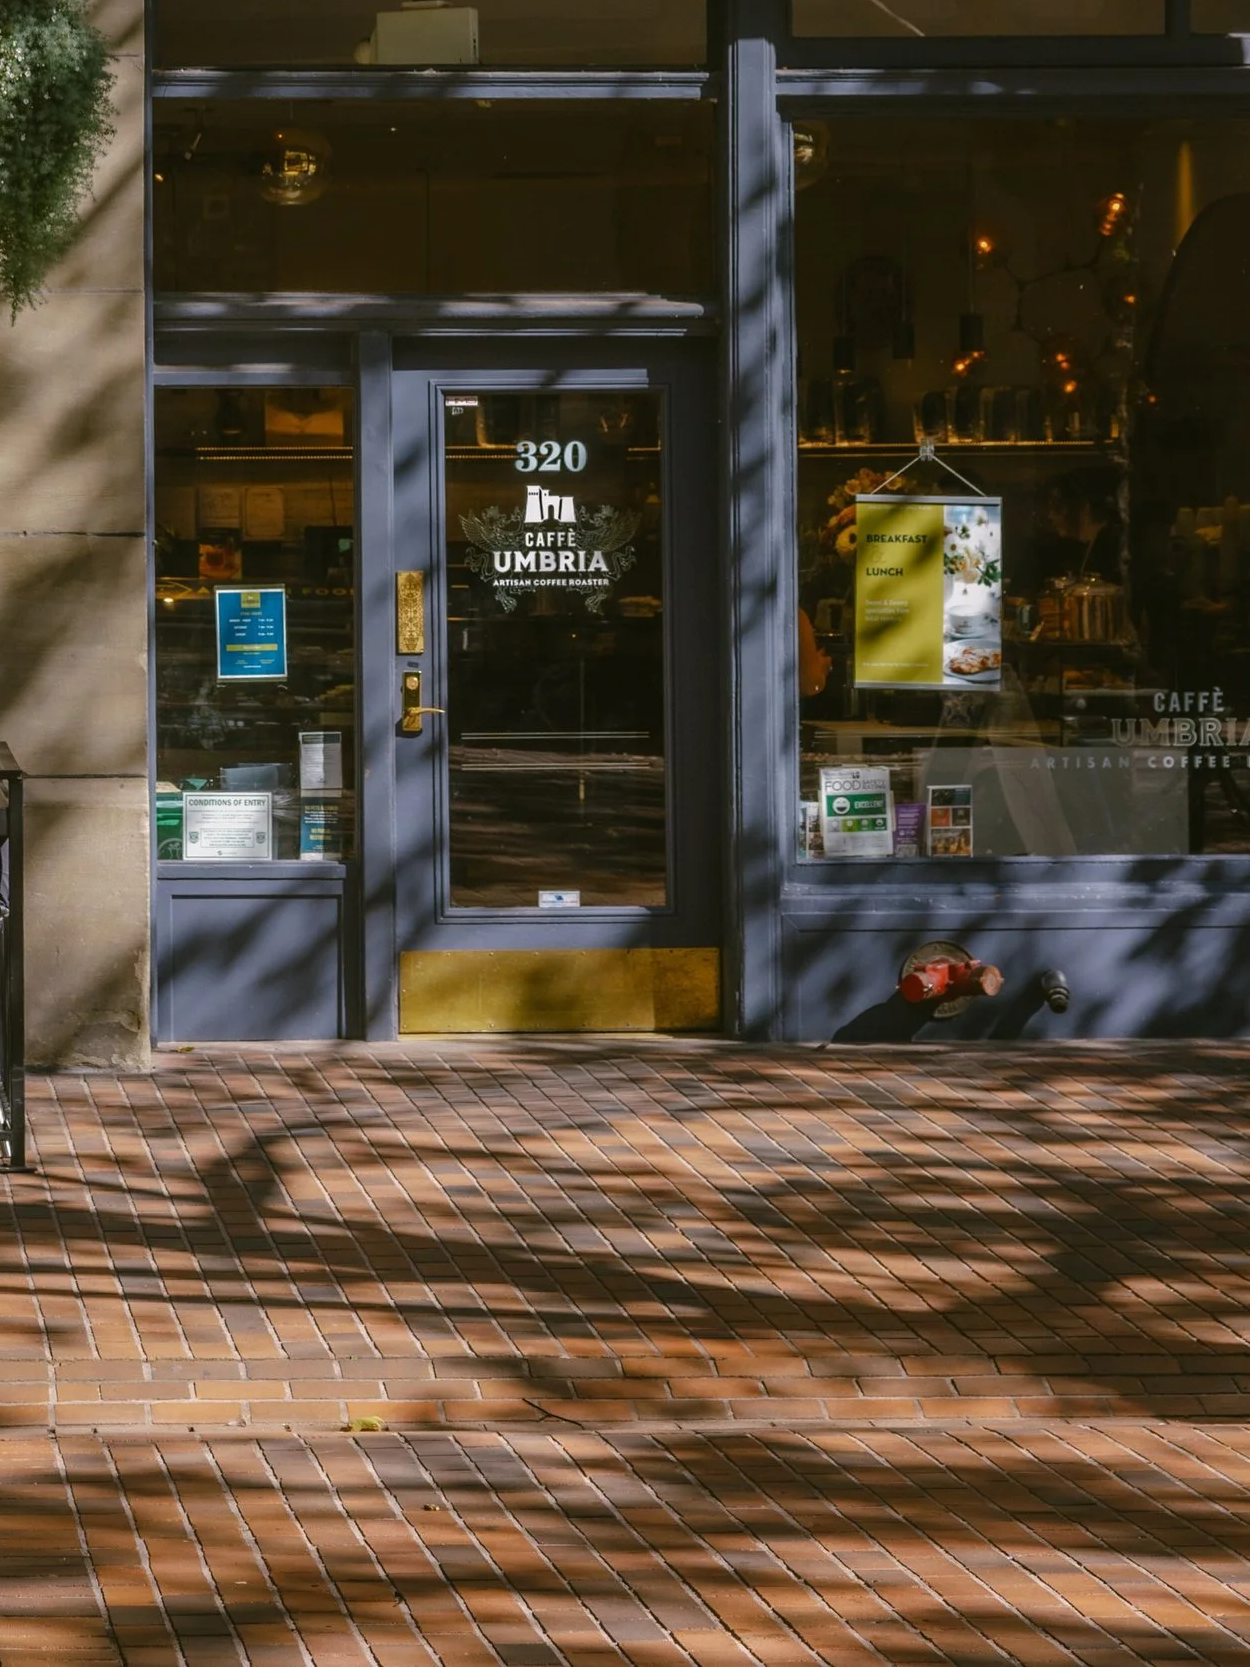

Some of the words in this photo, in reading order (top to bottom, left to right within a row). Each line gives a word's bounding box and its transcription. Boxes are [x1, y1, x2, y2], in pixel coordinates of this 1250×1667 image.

[515, 440, 588, 472] 320
[524, 528, 577, 548] CAFFÈ
[866, 534, 928, 543] BREAKFAST
[493, 550, 610, 573] UMBRIA
[866, 568, 903, 576] LUNCH
[1153, 687, 1225, 713] CAFFÈ
[1030, 756, 1131, 769] ARTISAN
[1147, 756, 1231, 769] COFFEE
[825, 780, 861, 791] FOOD
[188, 799, 232, 807] CONDITIONS
[234, 799, 243, 807] OF
[244, 799, 266, 807] ENTRY
